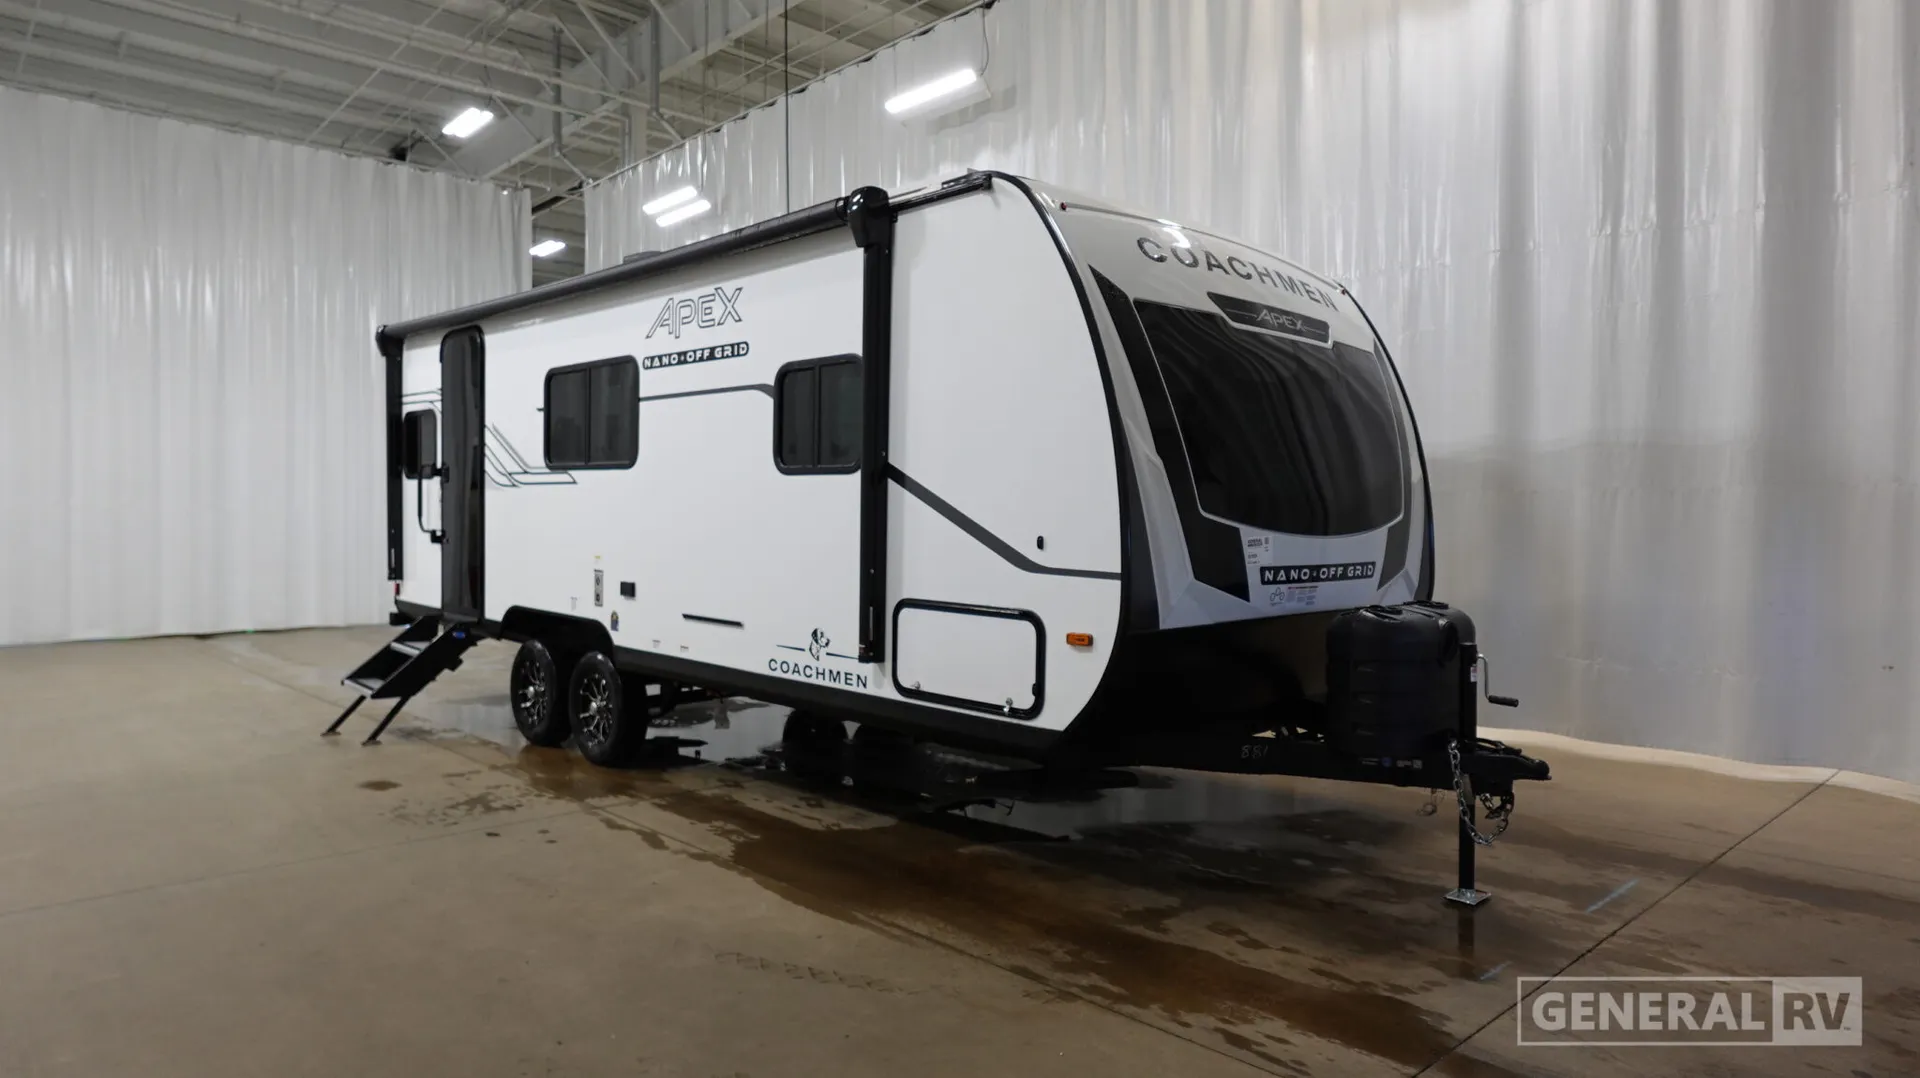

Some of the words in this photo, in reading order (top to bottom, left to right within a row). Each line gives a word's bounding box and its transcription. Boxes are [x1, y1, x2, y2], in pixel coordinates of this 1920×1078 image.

[1137, 237, 1339, 311] COACHMEN
[645, 287, 743, 339] APEX
[1256, 309, 1304, 331] APEX
[644, 354, 678, 369] NANO
[714, 343, 748, 357] GRID
[1264, 568, 1310, 582] NANO
[1320, 567, 1343, 579] OFF
[1347, 564, 1374, 577] GRID
[768, 658, 868, 689] COACHMEN
